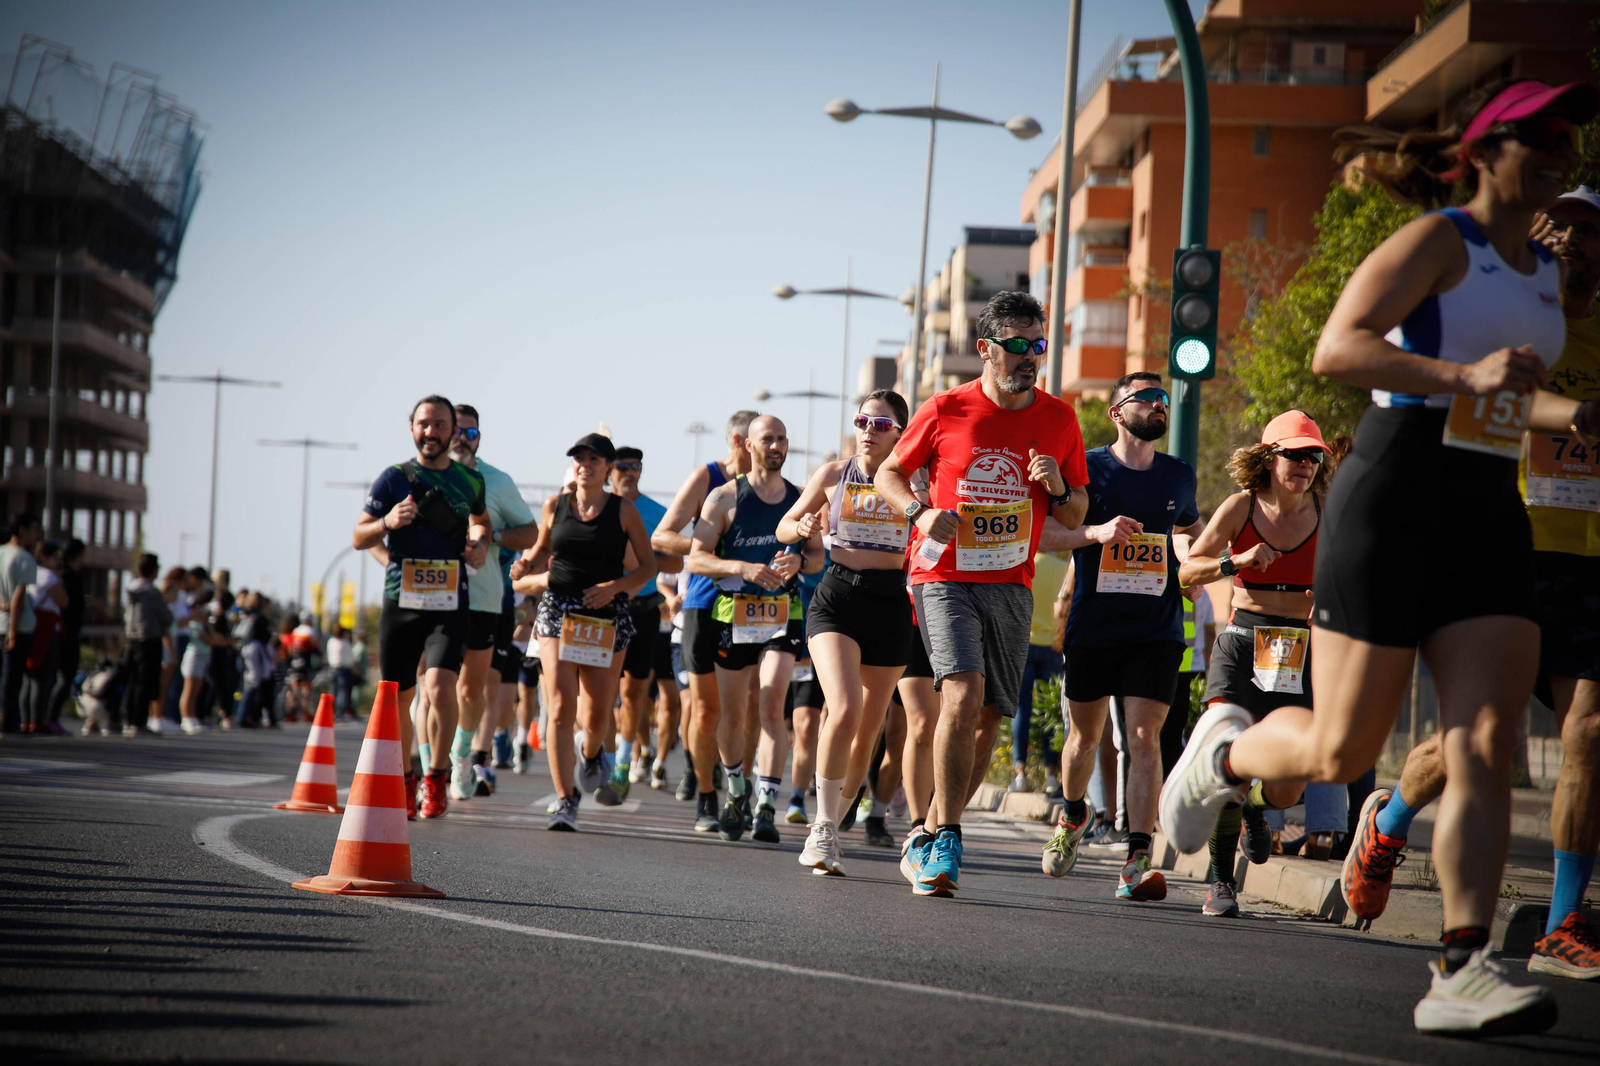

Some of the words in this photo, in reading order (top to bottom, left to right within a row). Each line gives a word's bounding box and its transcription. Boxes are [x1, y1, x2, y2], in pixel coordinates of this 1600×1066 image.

[960, 484, 979, 492] SAN
[980, 486, 1026, 497] SILVESTRE
[973, 514, 1019, 536] 968
[1109, 542, 1163, 563] 1028
[414, 569, 448, 584] 559
[745, 602, 778, 617] 810
[573, 623, 604, 641] 111
